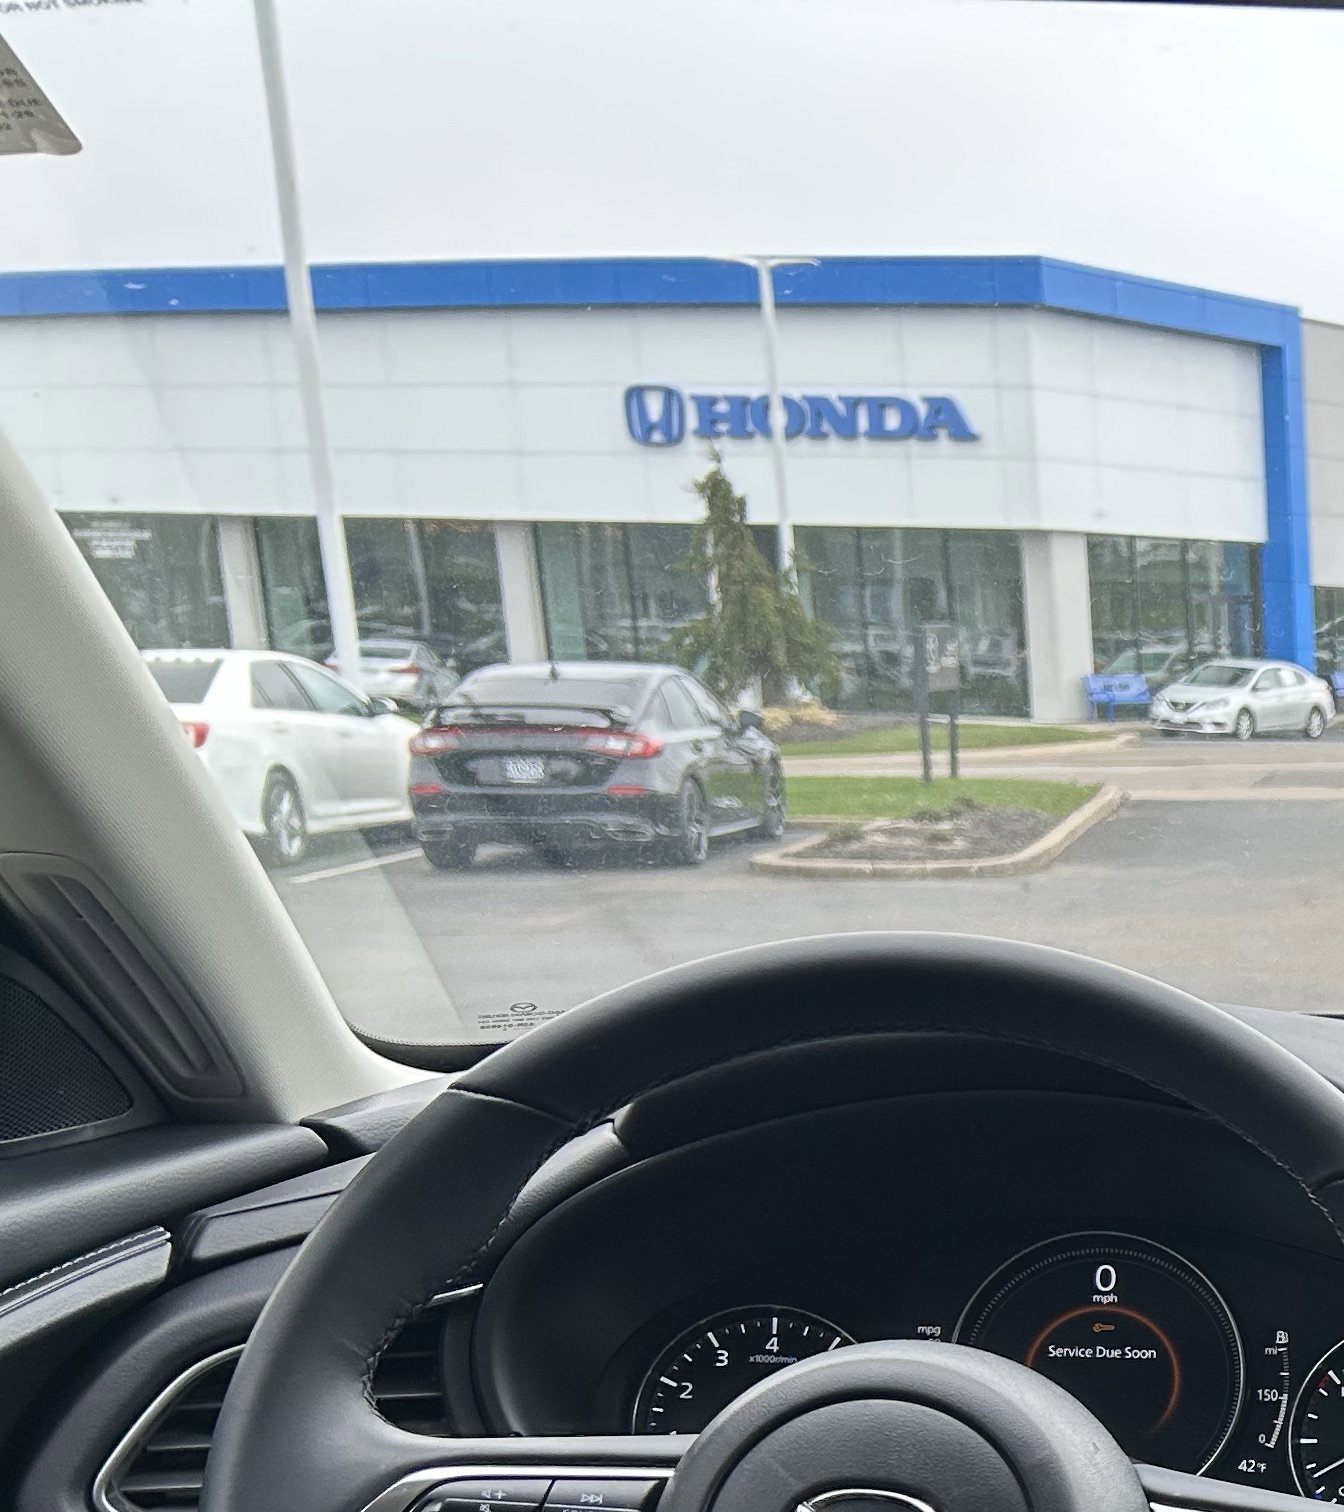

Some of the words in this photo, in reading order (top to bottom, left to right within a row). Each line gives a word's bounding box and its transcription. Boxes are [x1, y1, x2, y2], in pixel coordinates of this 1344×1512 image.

[690, 395, 980, 442] HONDA
[1095, 1264, 1117, 1291] 0
[1092, 1292, 1118, 1304] mph
[917, 1325, 941, 1337] mpg
[764, 1336, 780, 1353] 4
[1264, 1346, 1278, 1356] mi
[715, 1350, 729, 1367] 3
[1048, 1345, 1093, 1358] Service
[1096, 1346, 1122, 1358] Due
[1124, 1347, 1157, 1359] Soon
[679, 1383, 693, 1399] 2
[1257, 1389, 1279, 1401] 150
[1258, 1433, 1266, 1444] 0
[1237, 1459, 1267, 1473] 42°F
